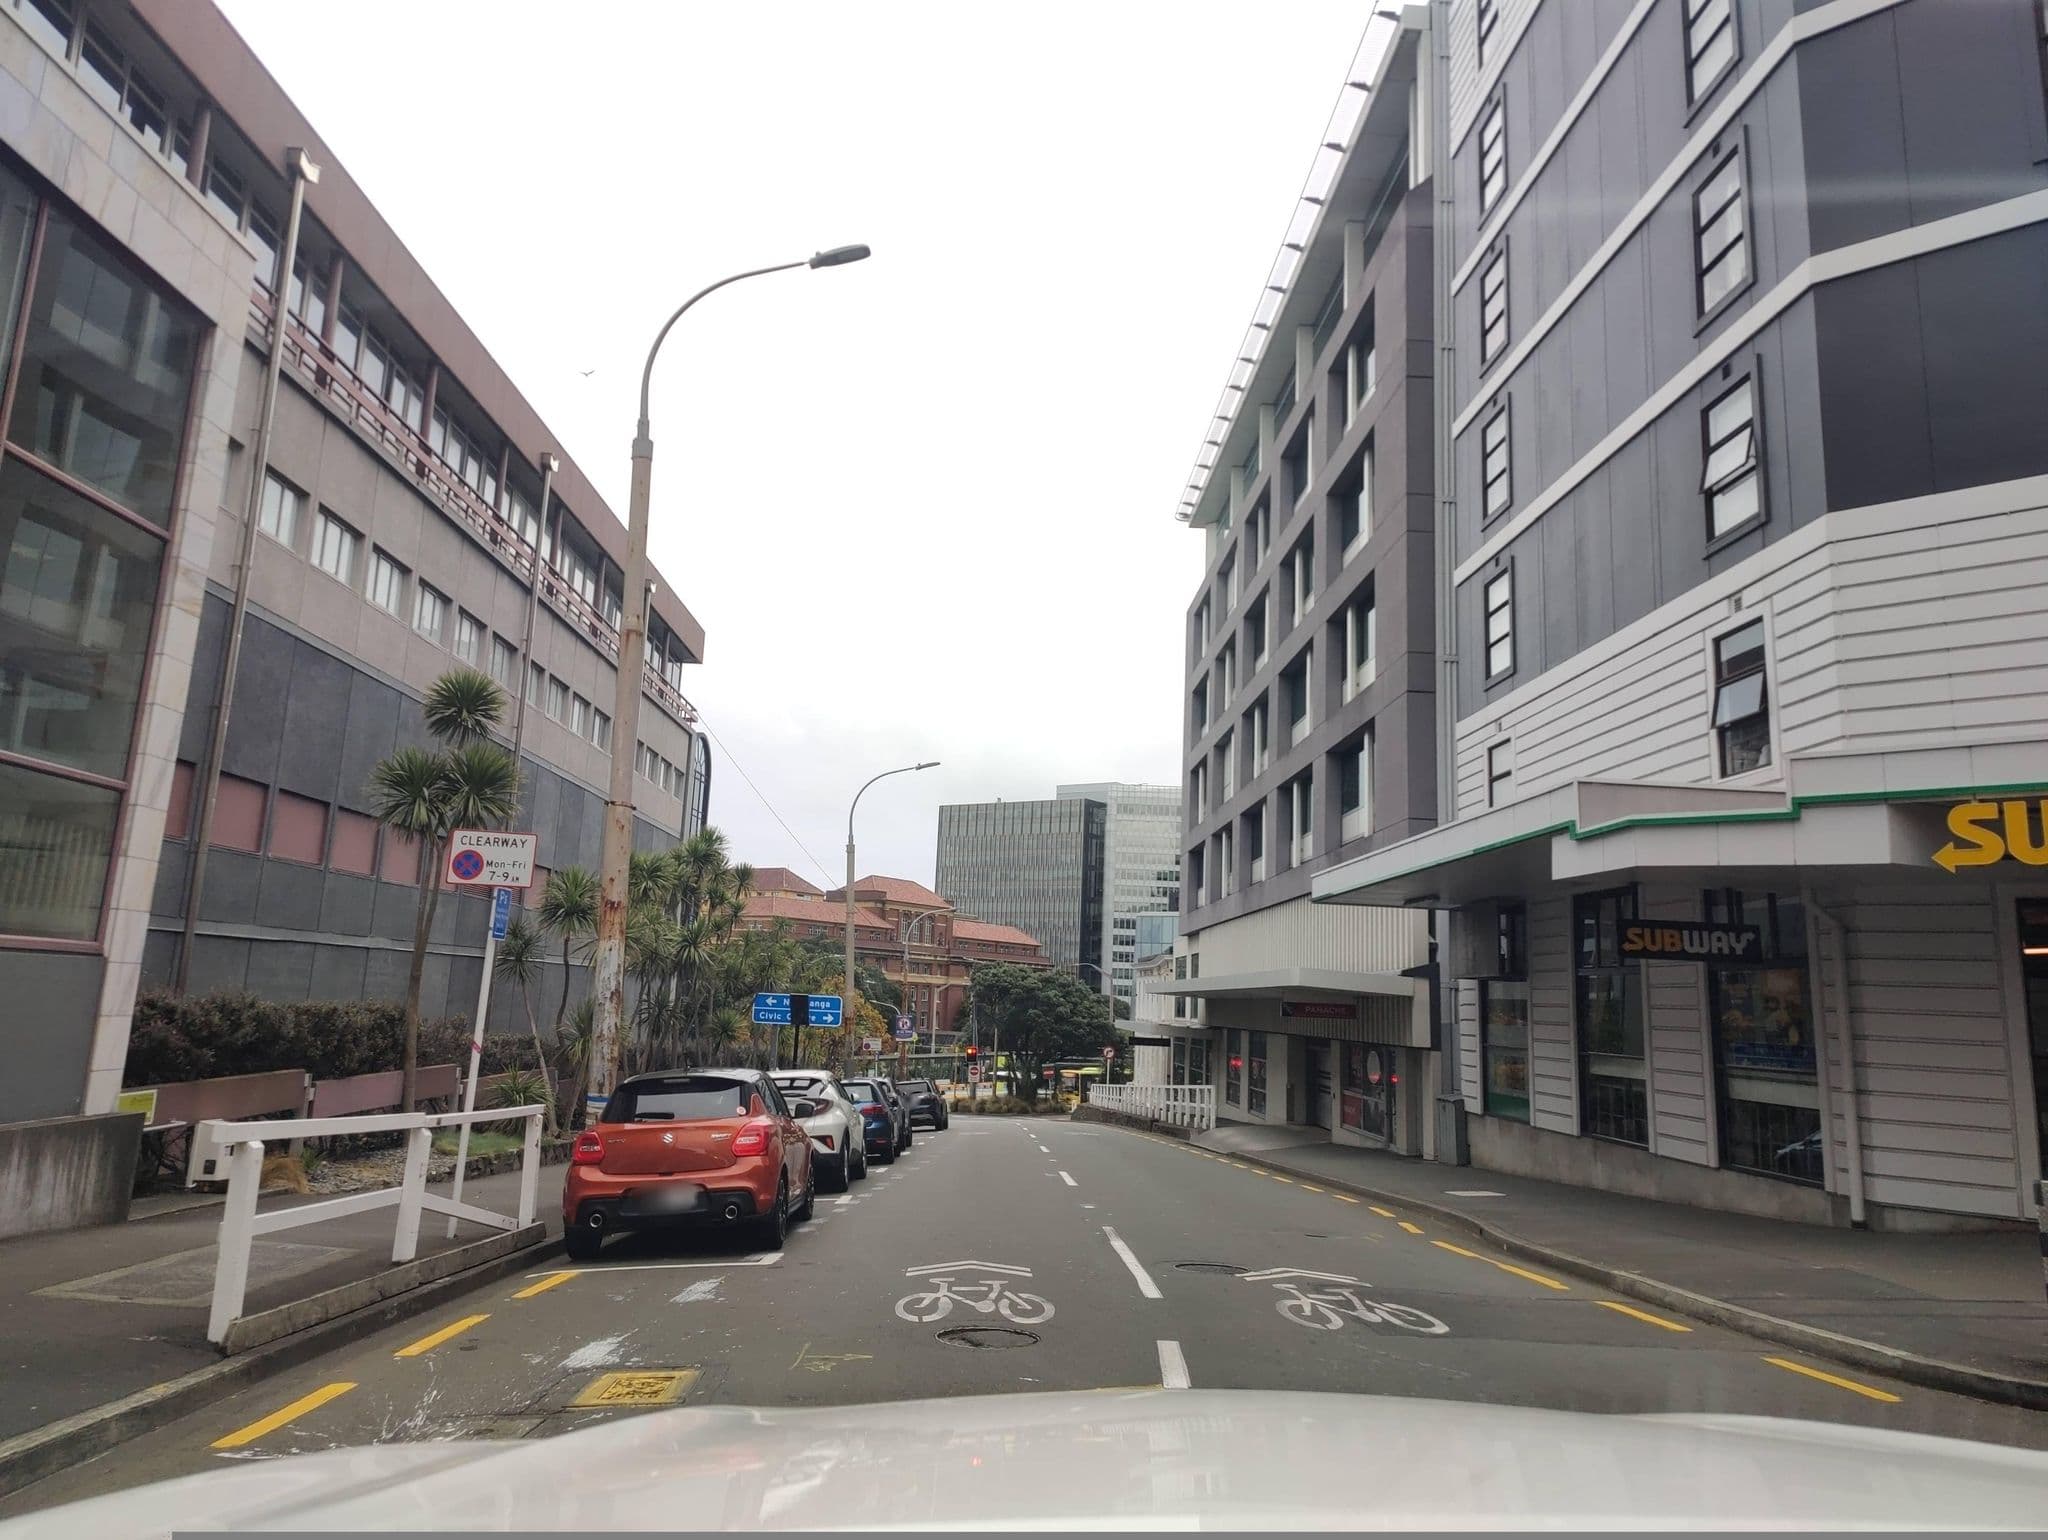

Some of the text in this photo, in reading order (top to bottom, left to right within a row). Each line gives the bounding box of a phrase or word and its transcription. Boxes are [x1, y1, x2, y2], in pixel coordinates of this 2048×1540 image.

[460, 835, 528, 849] CLEARWAY
[486, 860, 526, 869] Mon-Fri
[489, 870, 510, 881] 7-9
[1622, 927, 1755, 955] SUBWAY
[759, 1011, 782, 1020] Civic
